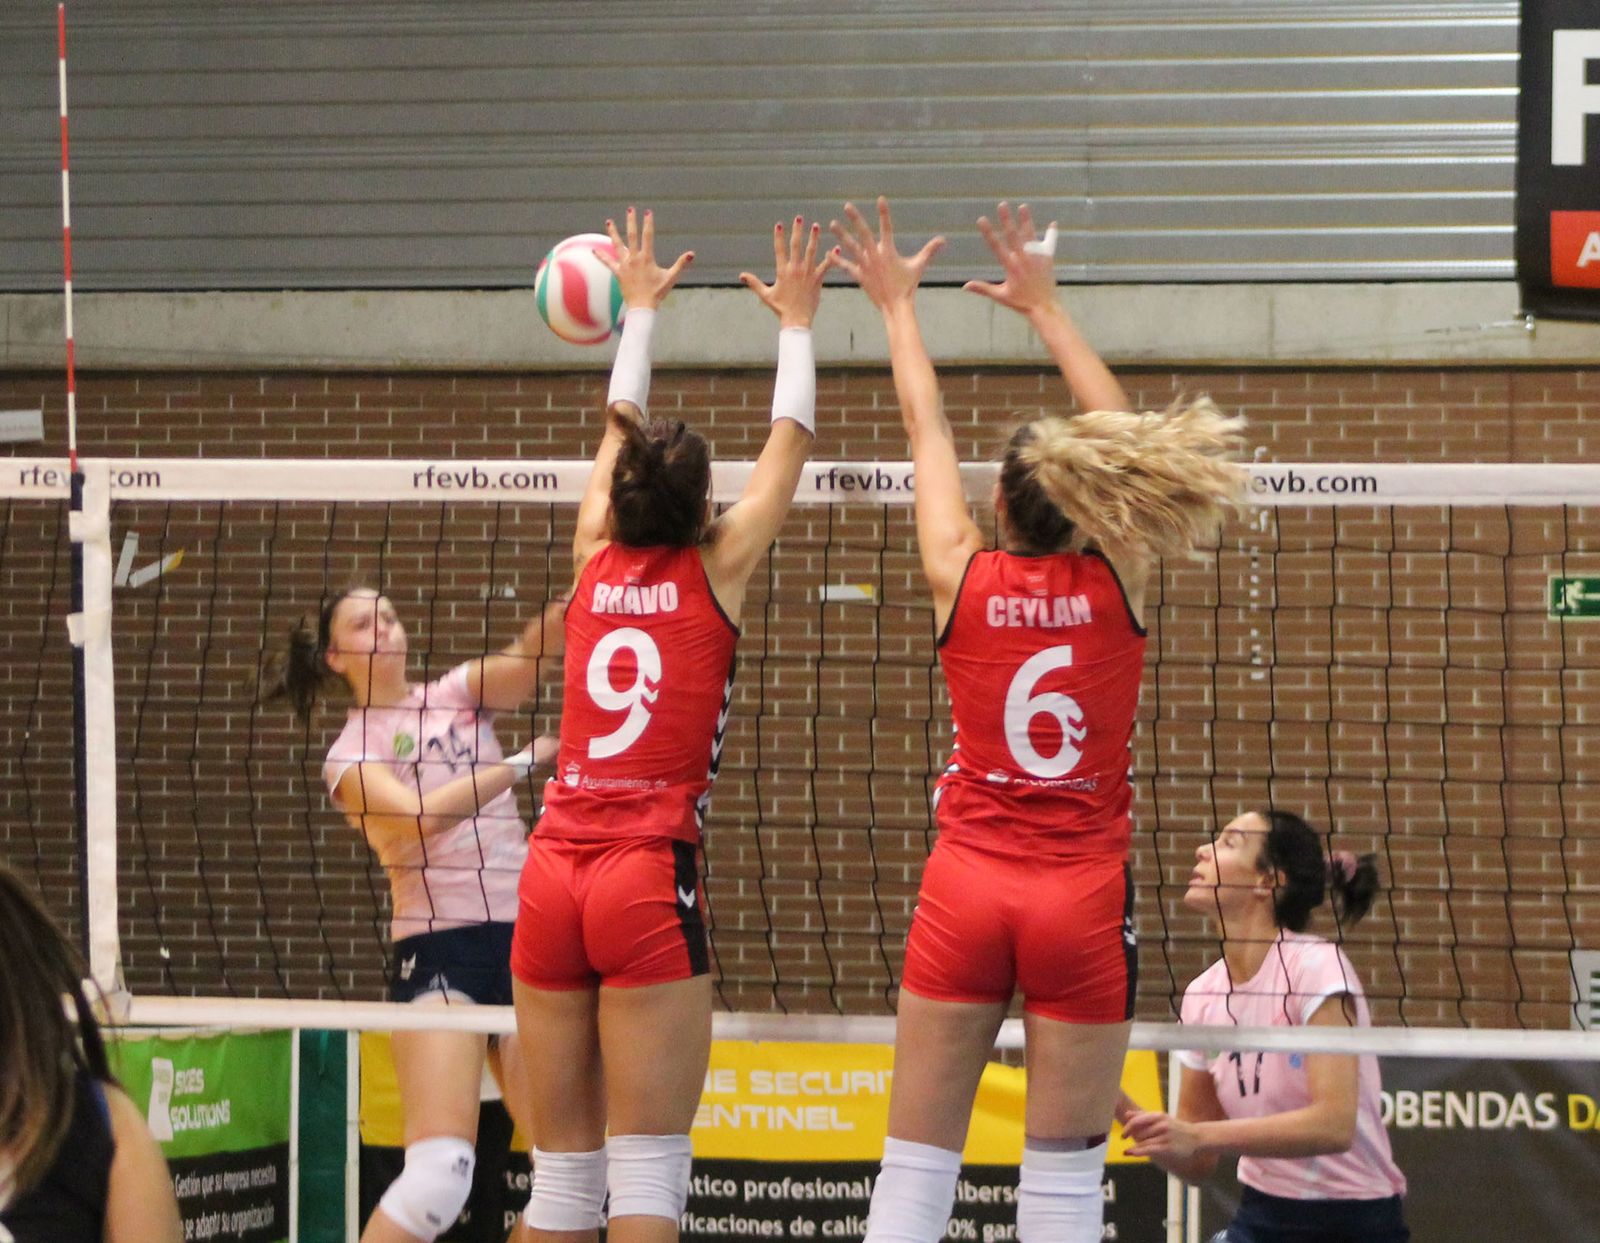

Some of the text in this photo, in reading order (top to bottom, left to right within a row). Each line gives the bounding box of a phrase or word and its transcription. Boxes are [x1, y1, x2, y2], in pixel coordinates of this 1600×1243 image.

[413, 467, 557, 489] rfevb.com
[815, 468, 914, 490] rfevb.c
[591, 581, 679, 615] BRAVO
[986, 594, 1092, 628] CEYLAN
[586, 626, 662, 759] 9
[1003, 645, 1087, 778] 6
[692, 1104, 855, 1130] ENTINEL
[744, 1176, 871, 1204] profesional
[789, 1215, 816, 1237] de
